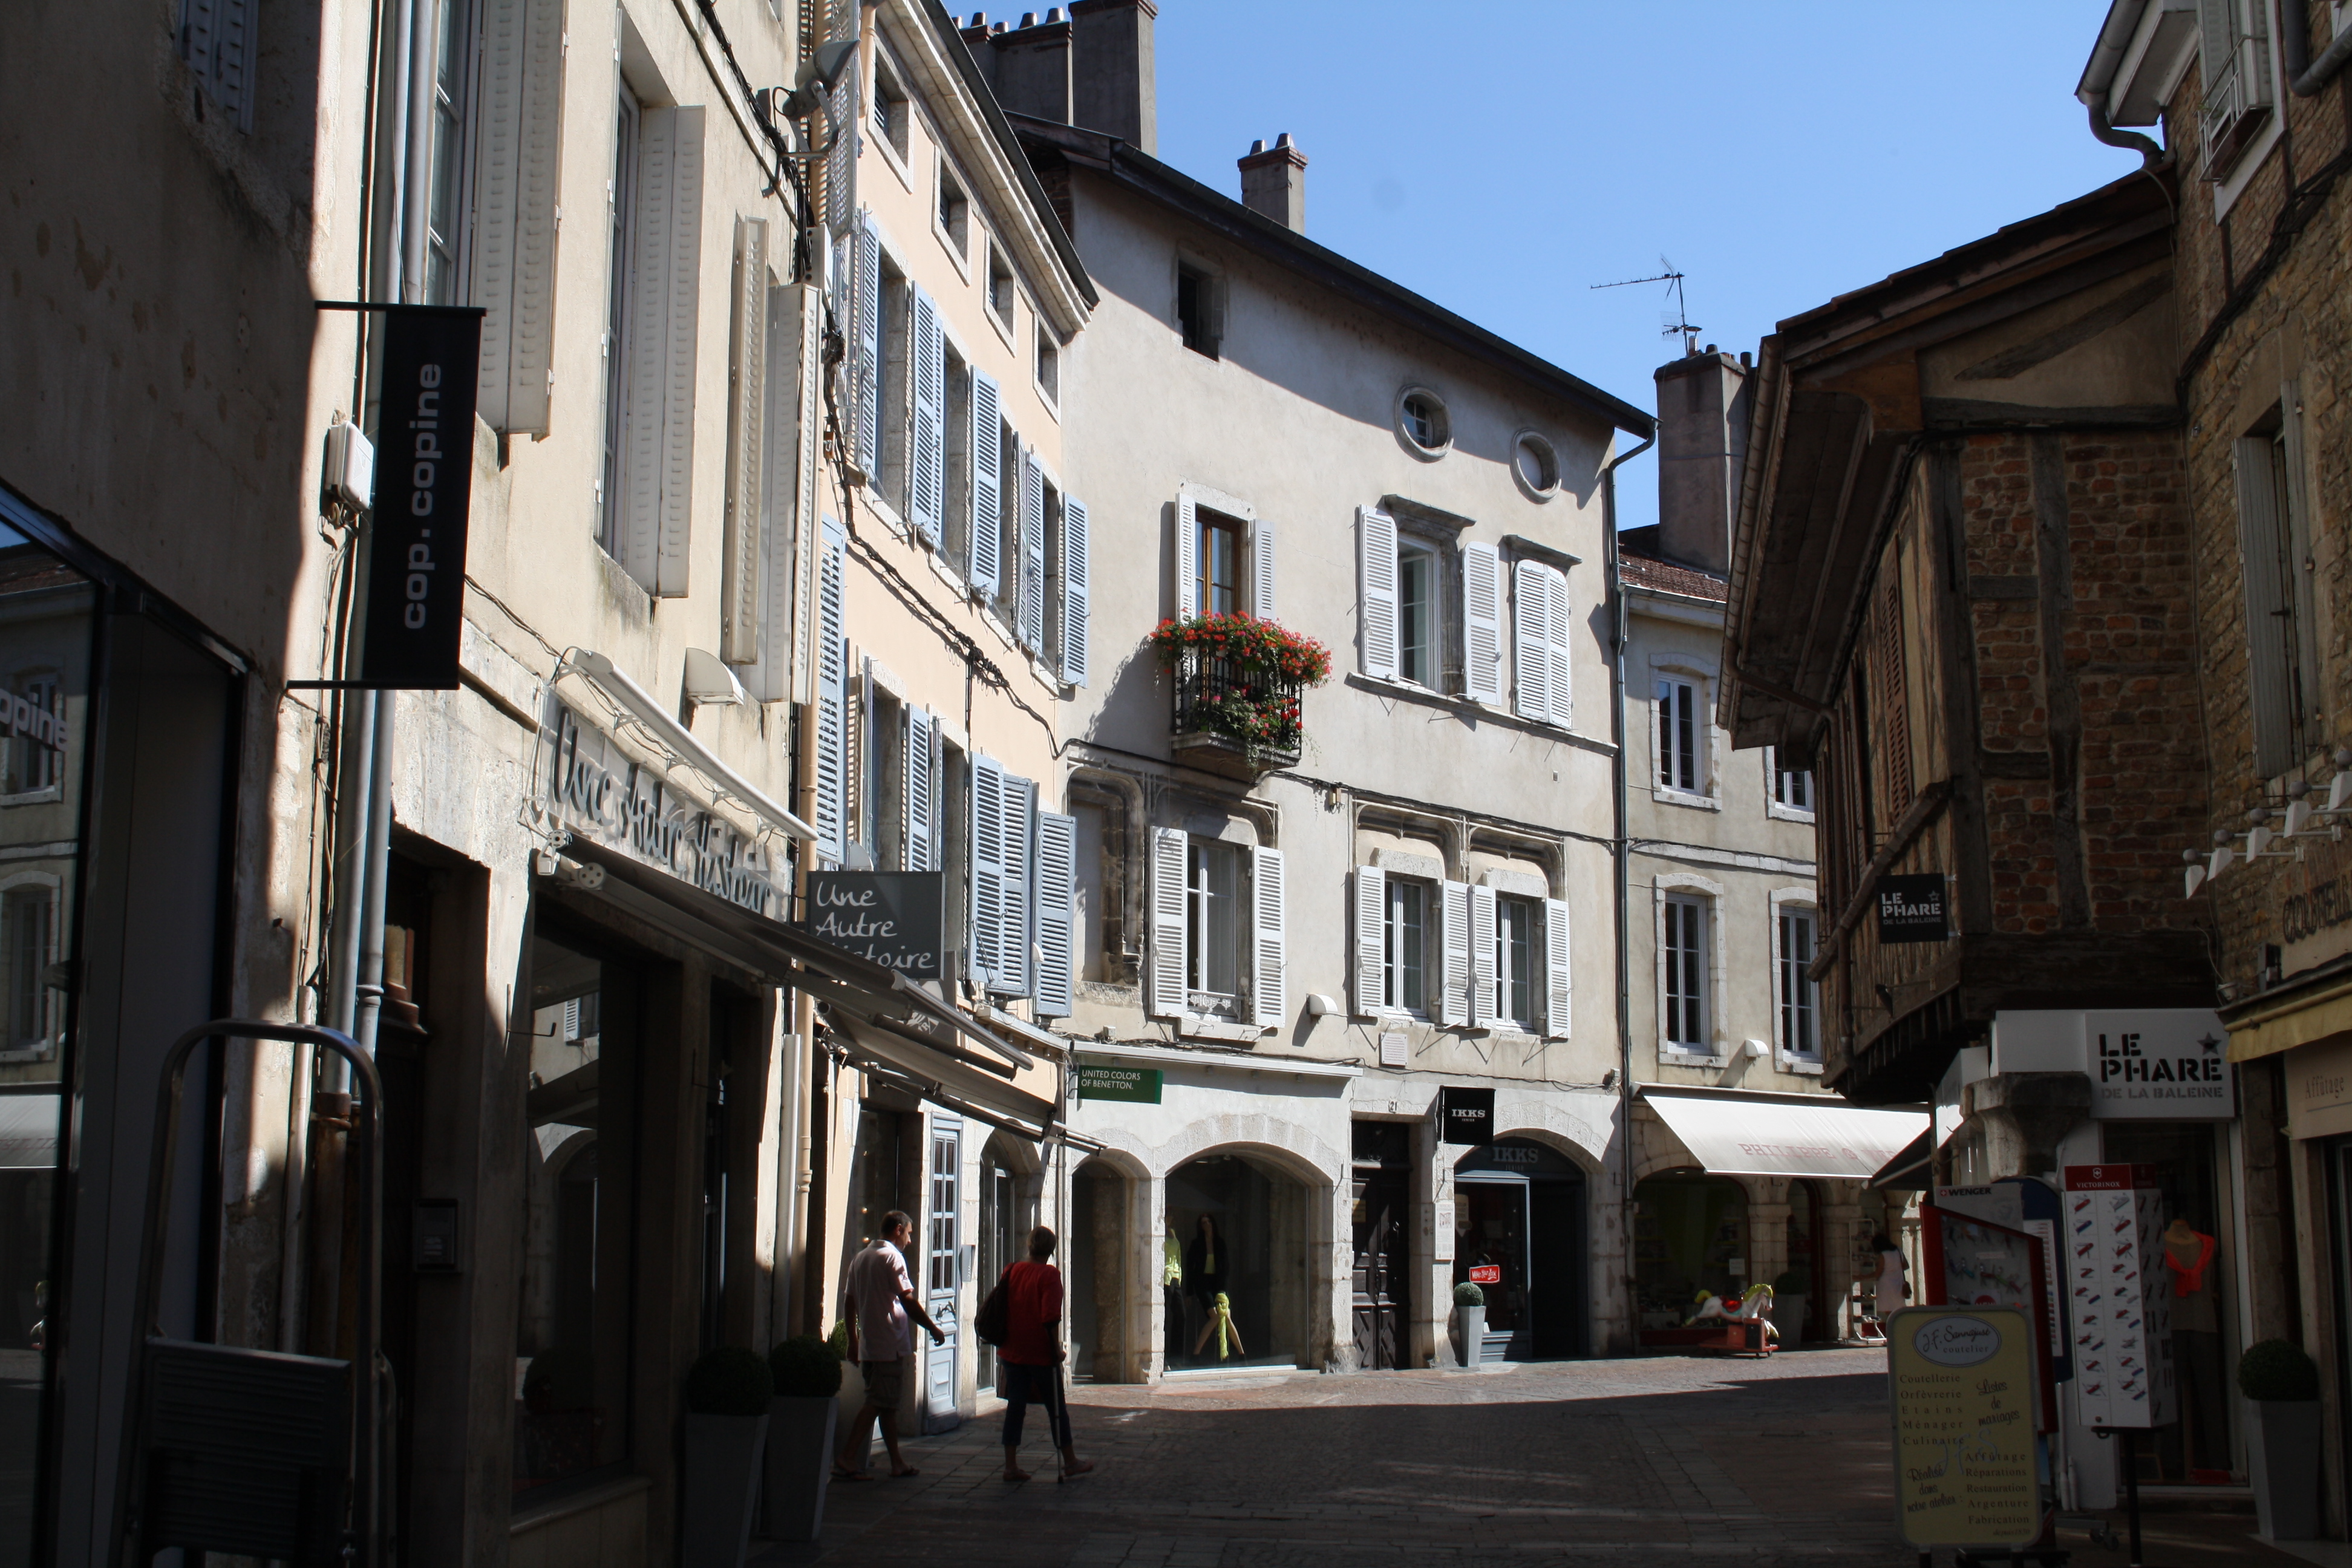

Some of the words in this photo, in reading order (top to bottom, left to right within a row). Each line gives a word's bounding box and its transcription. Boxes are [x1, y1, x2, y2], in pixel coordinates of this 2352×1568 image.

[404, 363, 442, 630] cop.copine
[553, 705, 615, 828] Une
[620, 762, 686, 873] Autre
[817, 881, 877, 907] Une
[1881, 892, 1903, 904] LE
[1882, 903, 1941, 917] PHARE
[815, 912, 897, 937] Autre
[2099, 1033, 2141, 1056] LE
[1082, 1069, 1109, 1079] UNITED
[1111, 1071, 1141, 1081] COLORS
[2100, 1058, 2222, 1082] PHARE
[1093, 1080, 1134, 1089] BENETTON.
[2101, 1088, 2122, 1099] DE
[2128, 1088, 2149, 1099] LA
[2154, 1087, 2223, 1099] BALEINE
[1452, 1109, 1486, 1118] IKKS
[1493, 1147, 1538, 1163] IKKS
[1738, 1143, 1836, 1158] PHILIPPE
[1949, 1187, 1992, 1197] WENGER
[1943, 1344, 1989, 1354] coutelier
[1900, 1373, 1960, 1383] Coutellerie
[1976, 1378, 2007, 1395] Listes
[1901, 1390, 1961, 1399] Orfèvrerie
[1991, 1396, 2001, 1410] de
[1902, 1406, 1962, 1414] Etains
[1978, 1410, 2020, 1426] mariages
[1903, 1420, 1963, 1431] Ménager
[1903, 1436, 1964, 1446] Culinaire
[1965, 1452, 2026, 1465] Affûtage
[1907, 1465, 1944, 1482] Réalisé
[1965, 1468, 2027, 1478] Réparations
[1919, 1482, 1938, 1495] dans
[1967, 1483, 2027, 1493] Restauration
[1907, 1501, 1926, 1513] notre
[1930, 1493, 1956, 1509] atelier
[1968, 1499, 2029, 1510] Argenture
[1968, 1515, 2030, 1524] Fabrication
